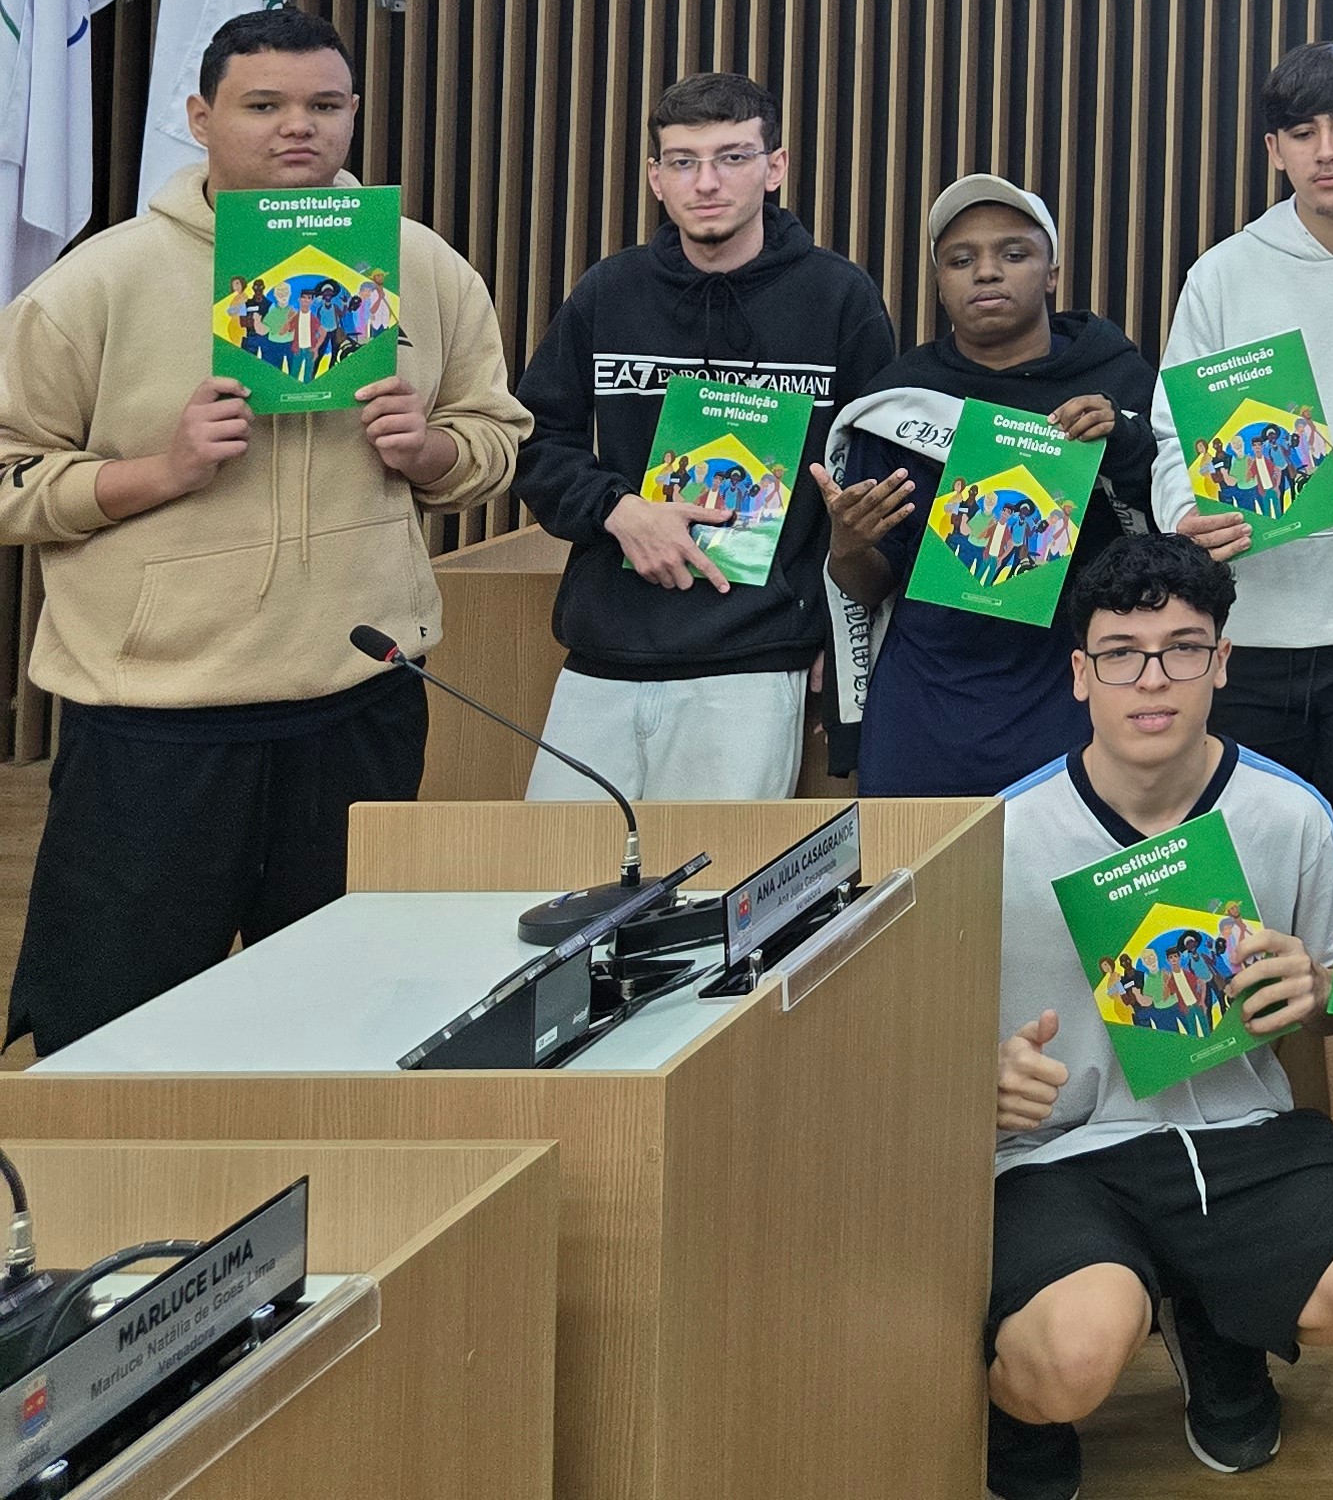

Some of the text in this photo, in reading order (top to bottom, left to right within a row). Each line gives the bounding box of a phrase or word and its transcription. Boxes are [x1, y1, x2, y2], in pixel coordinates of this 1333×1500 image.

[258, 196, 361, 211] Constituição
[267, 215, 352, 229] em Miúdos
[594, 360, 656, 389] EA7
[767, 373, 831, 396] ARMANI
[1196, 347, 1275, 379] Constituição
[1208, 364, 1273, 393] em Miúdos
[699, 386, 779, 409] Constituição
[702, 406, 769, 425] em Miúdos
[993, 414, 1066, 441] Constituiçã
[995, 434, 1016, 447] em
[1016, 436, 1062, 456] Miúdos
[756, 820, 855, 904] ANA JÚLIA CASAGRANDE
[1092, 837, 1188, 887] Constituição
[1108, 858, 1187, 902] em Miúdos
[117, 1238, 254, 1352] MARLUCE LIMA
[90, 1354, 144, 1401] Marluce
[148, 1318, 192, 1356] Natália
[194, 1304, 210, 1323] de
[247, 1257, 276, 1287] Lima
[157, 1324, 216, 1374] Vereadora
